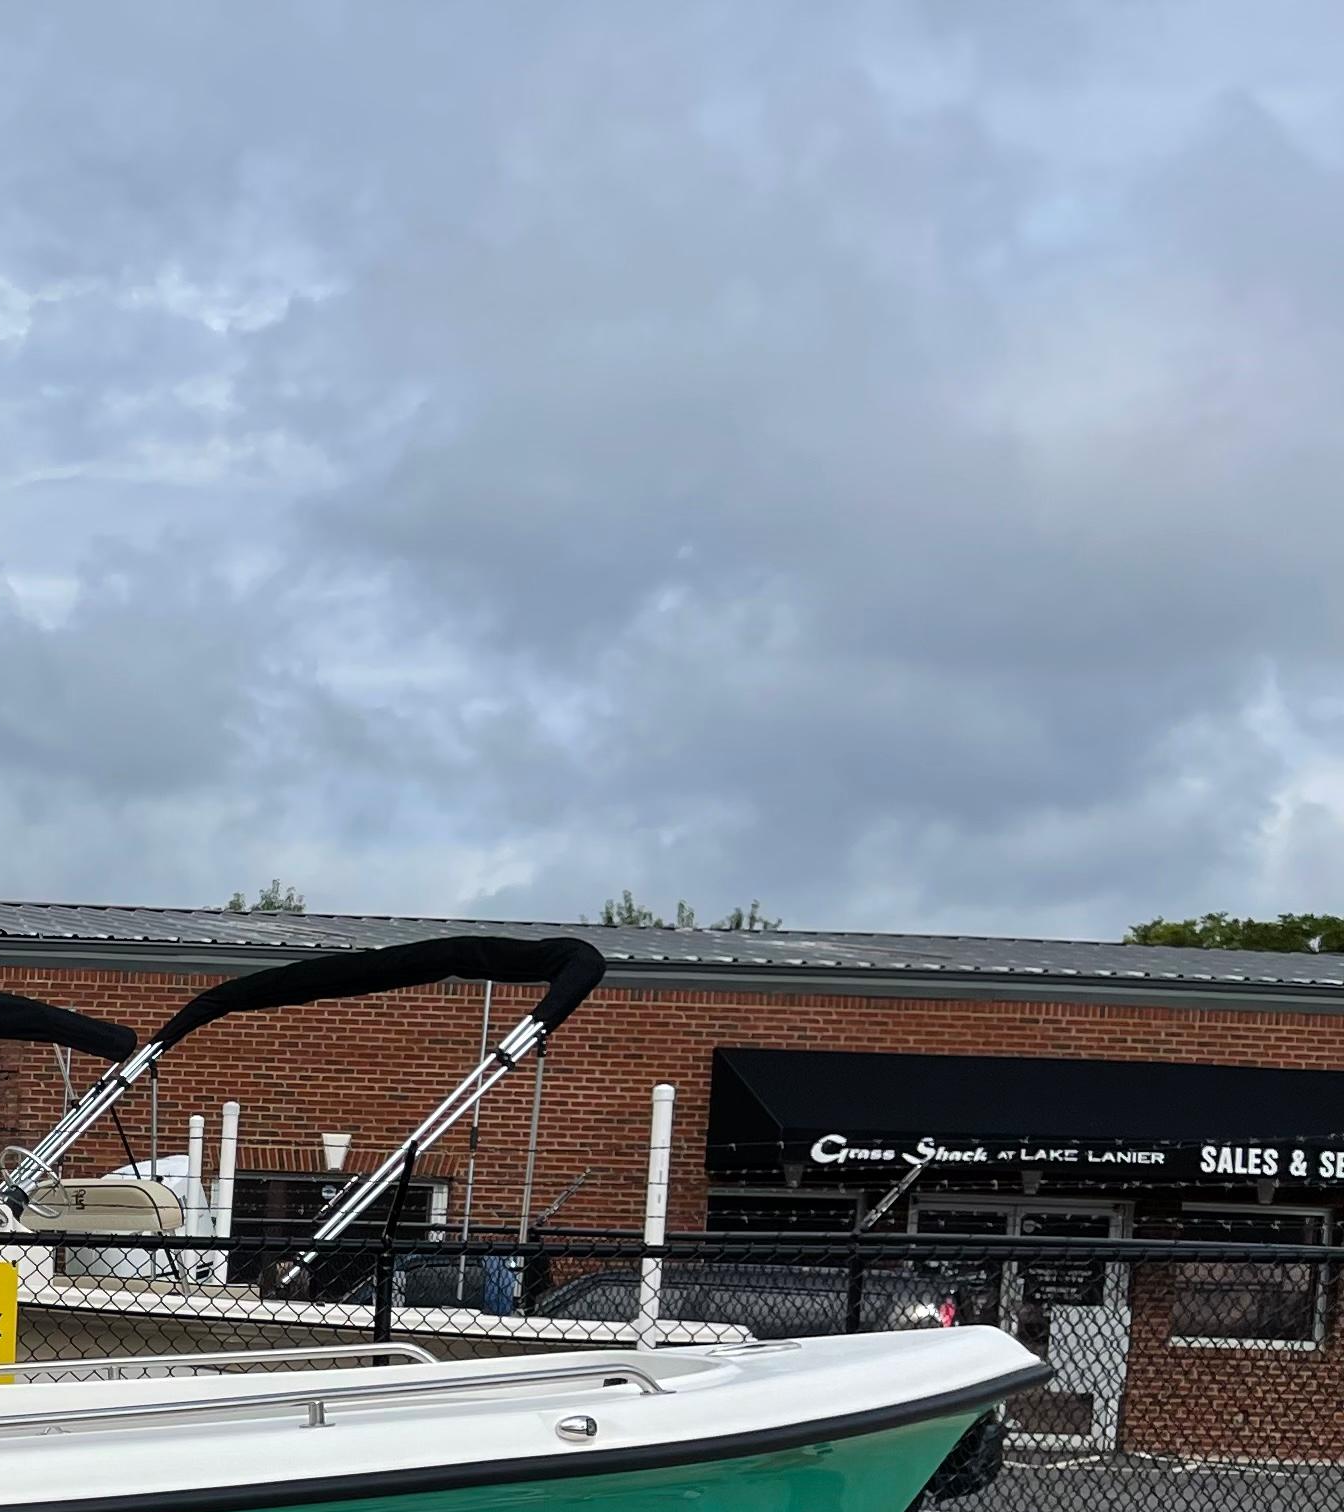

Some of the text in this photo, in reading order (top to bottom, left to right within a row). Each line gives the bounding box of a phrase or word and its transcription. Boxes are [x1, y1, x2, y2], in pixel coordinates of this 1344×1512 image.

[811, 1134, 1166, 1165] Grass Shack AT LAKE LANIER
[1200, 1145, 1279, 1176] SALES
[1289, 1149, 1308, 1177] &
